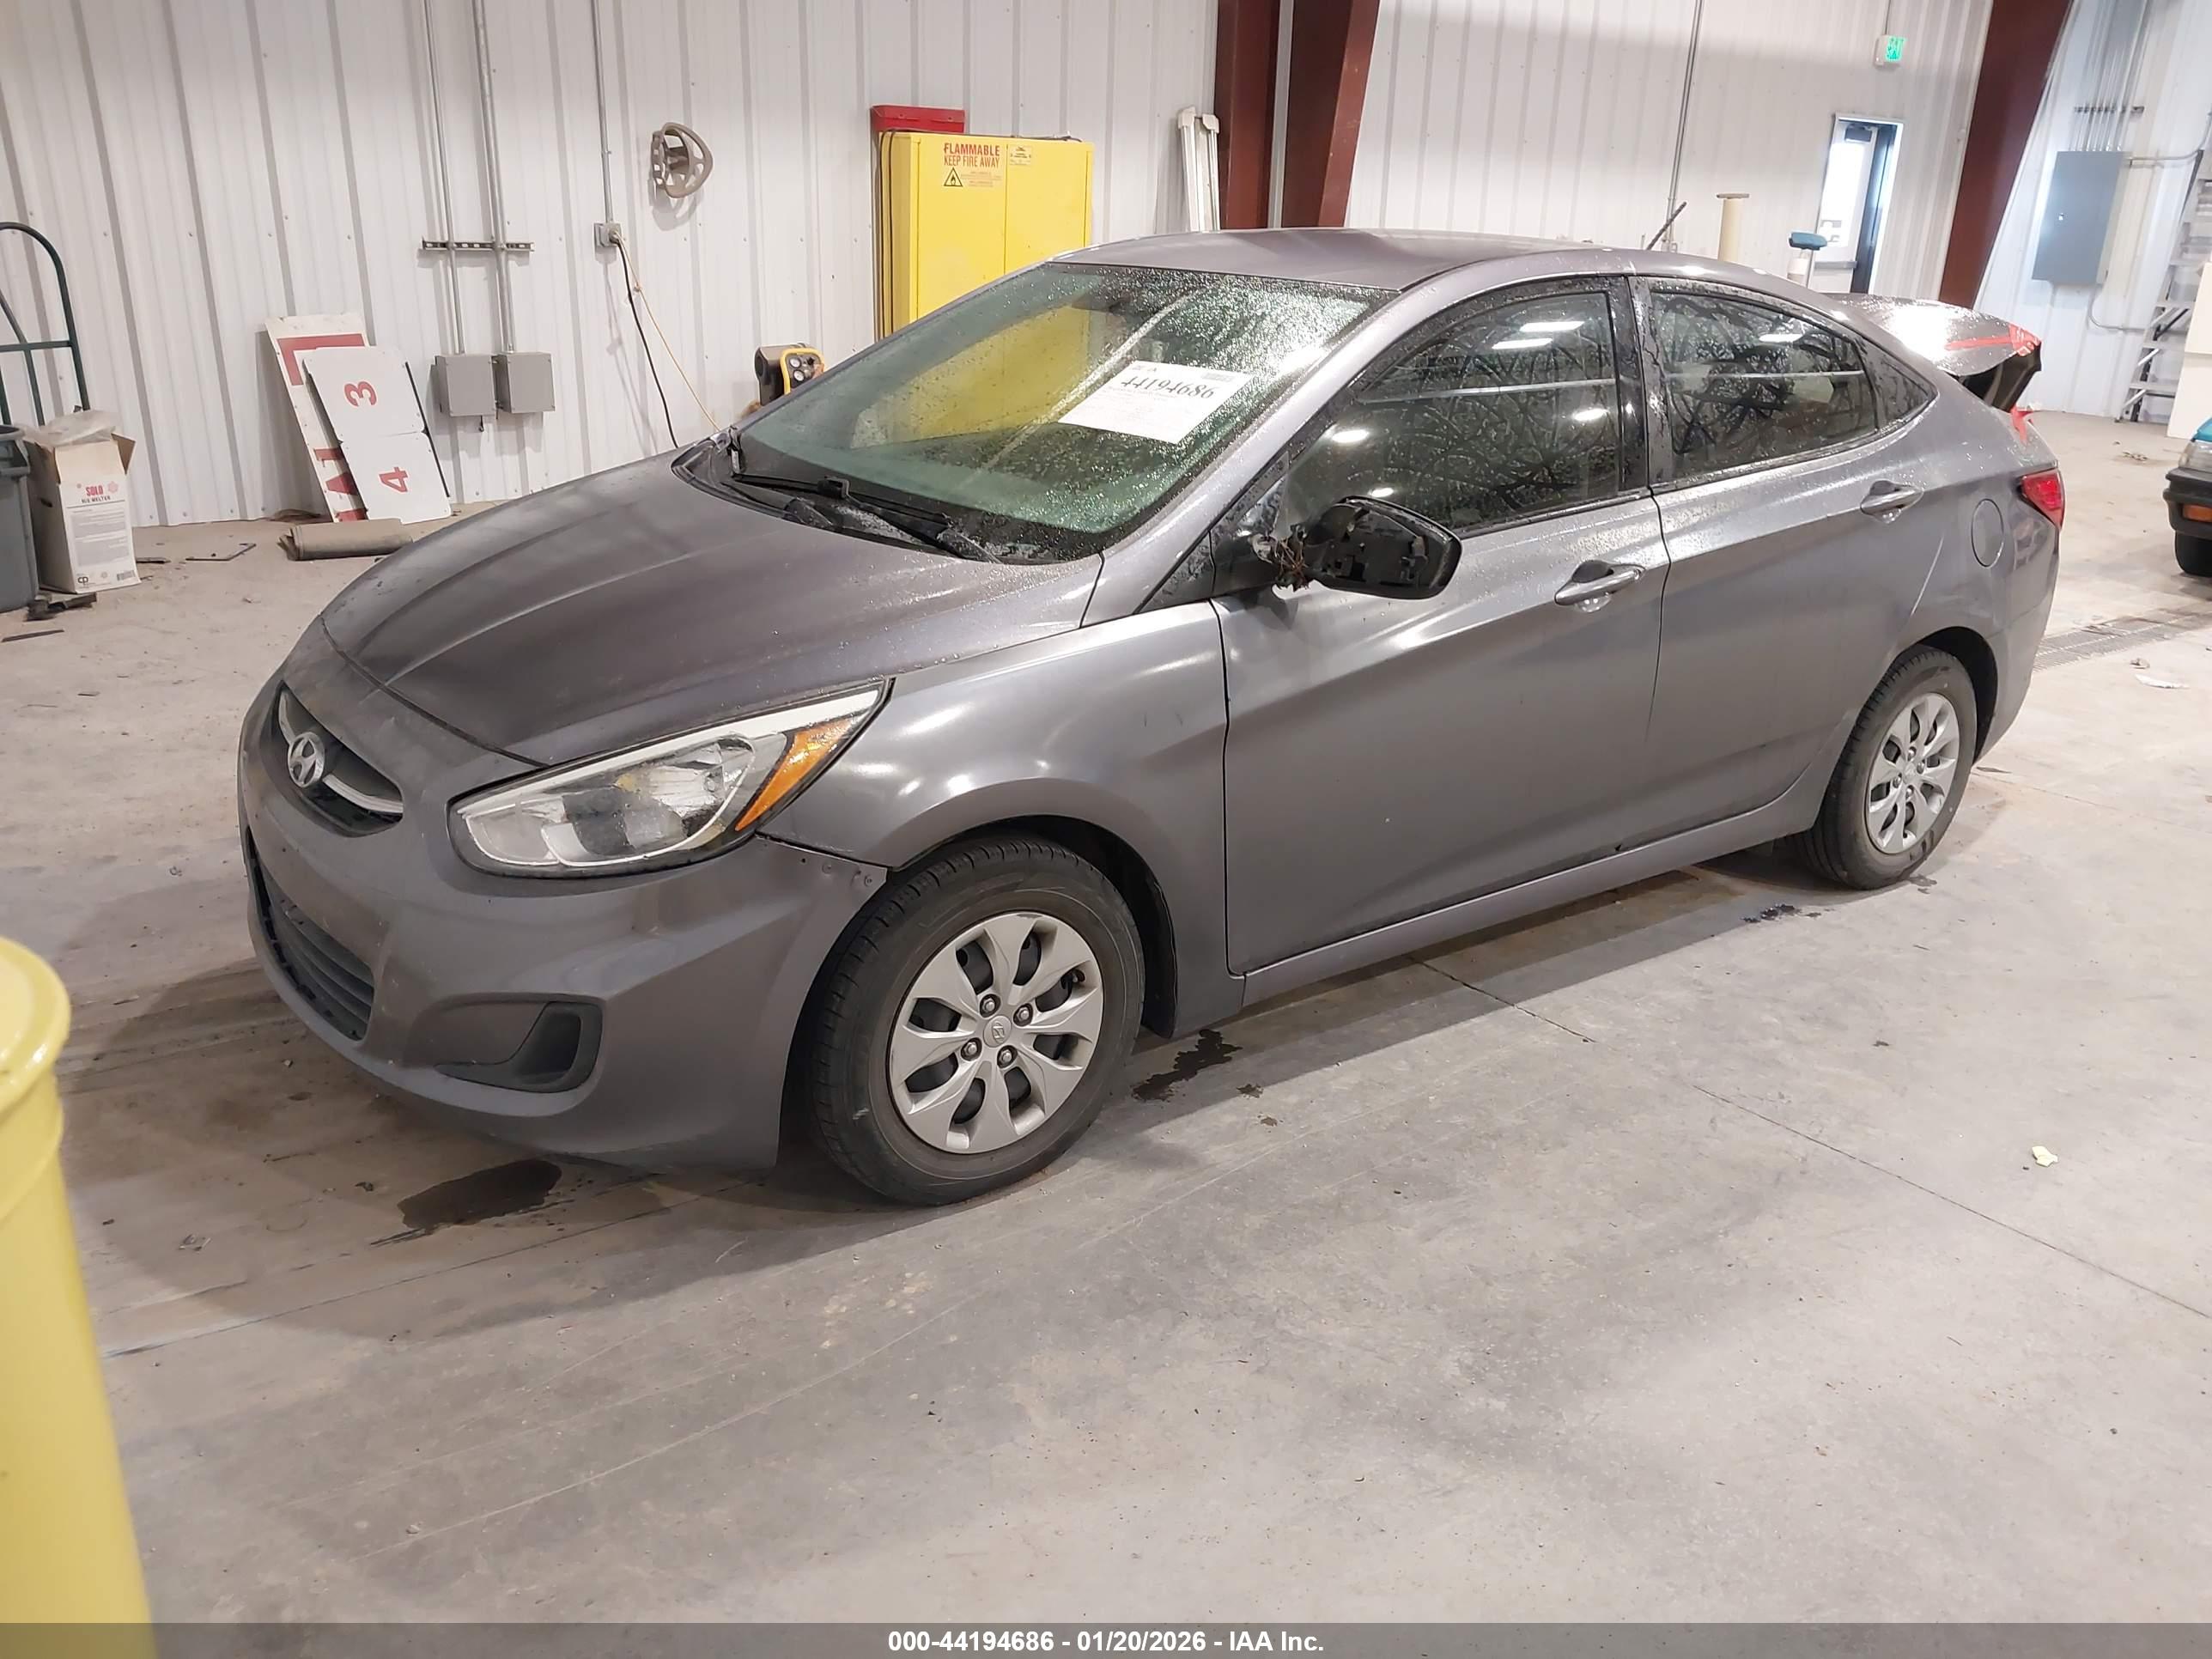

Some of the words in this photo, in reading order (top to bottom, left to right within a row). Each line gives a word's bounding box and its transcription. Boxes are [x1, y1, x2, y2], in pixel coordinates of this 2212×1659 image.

[944, 143, 1000, 156] FLAMMABLE
[944, 155, 961, 167] KEEP
[963, 155, 977, 167] FIRE
[980, 156, 1000, 168] AWAY
[343, 380, 378, 408] 3
[1120, 376, 1219, 399] 44194686
[378, 465, 410, 494] 4
[85, 485, 104, 496] SOLO
